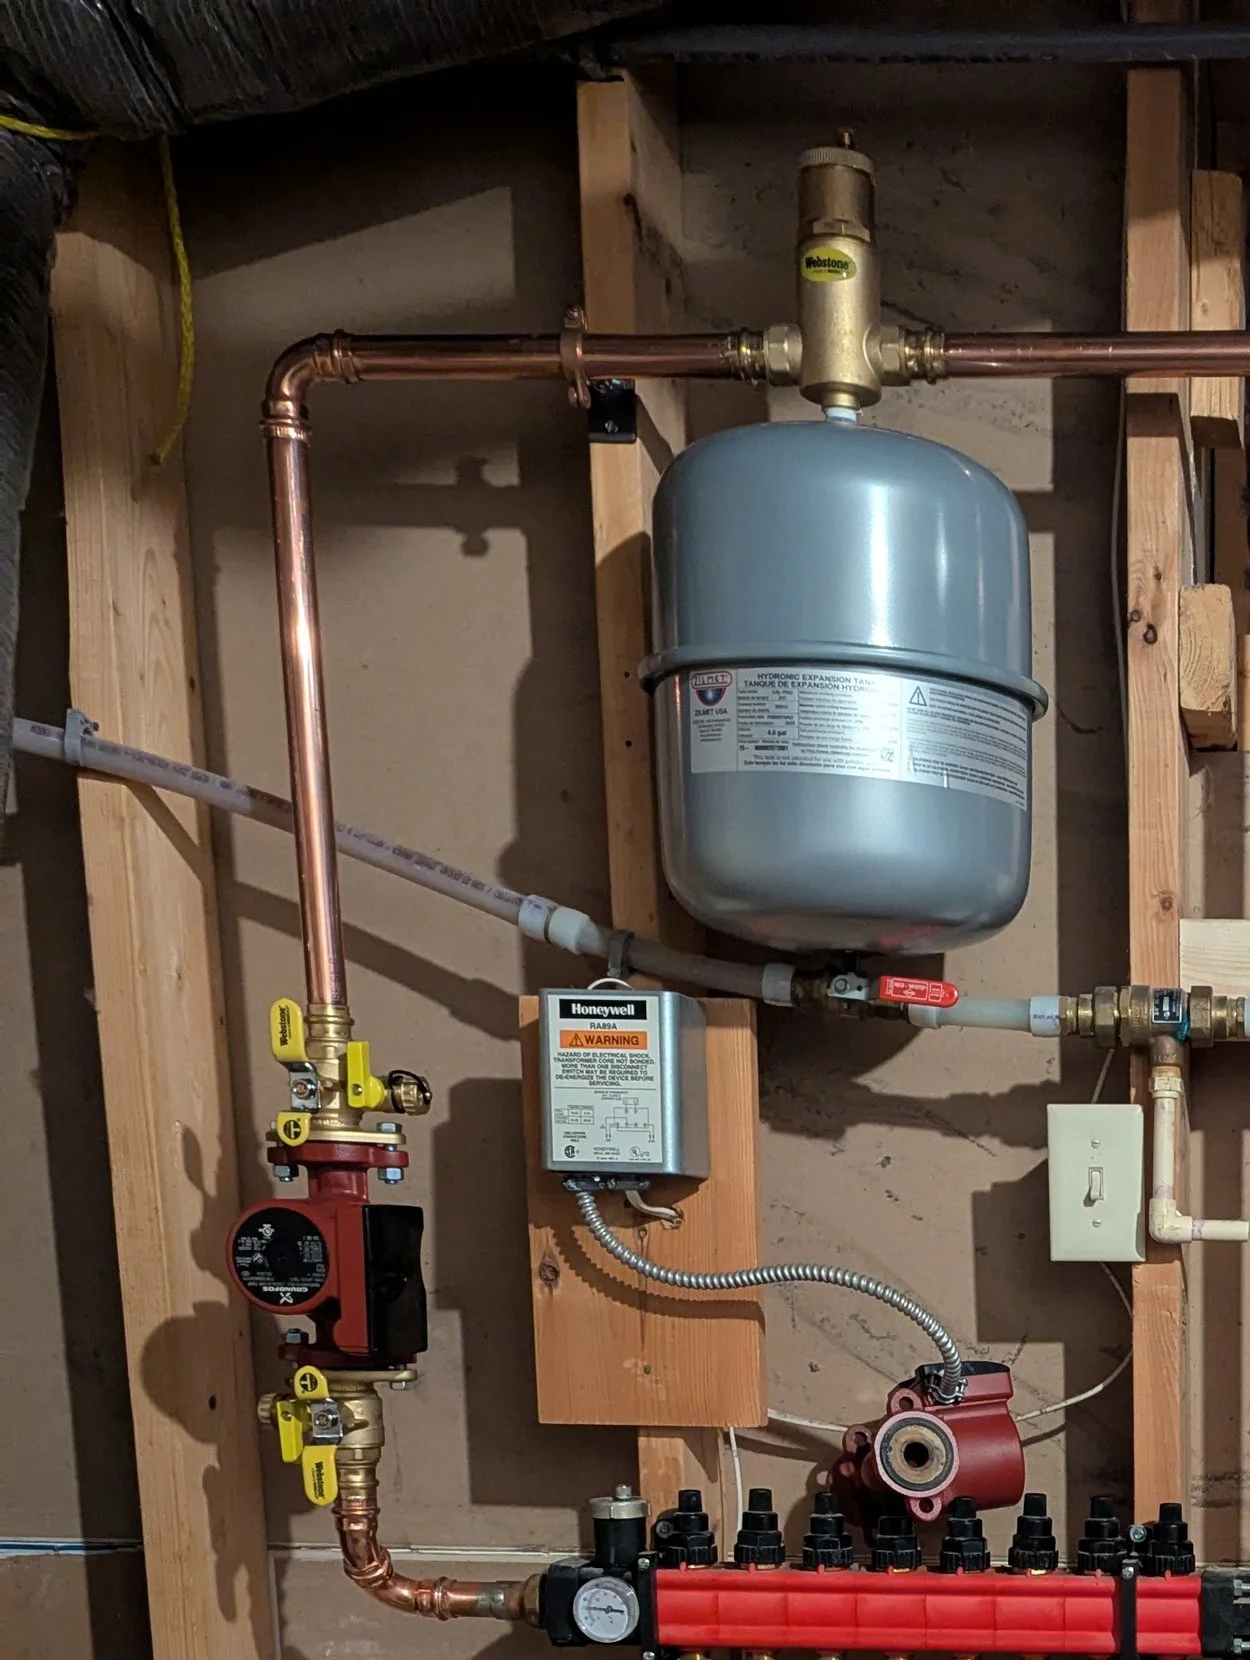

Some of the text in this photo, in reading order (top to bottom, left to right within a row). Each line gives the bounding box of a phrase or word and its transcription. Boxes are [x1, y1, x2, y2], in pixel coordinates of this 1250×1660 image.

[805, 256, 848, 270] Webstone
[693, 674, 726, 686] ZILMET
[744, 679, 841, 689] TANQUE DE EXPANSIÓN
[757, 673, 800, 681] HYDRONIC
[802, 675, 851, 684] EXPANSION
[715, 708, 728, 716] USA
[779, 729, 787, 737] gal
[571, 1003, 635, 1018] Honeywell
[279, 1006, 289, 1046] Webstone
[585, 1035, 639, 1046] WARNING
[315, 1461, 325, 1499] Webstone
